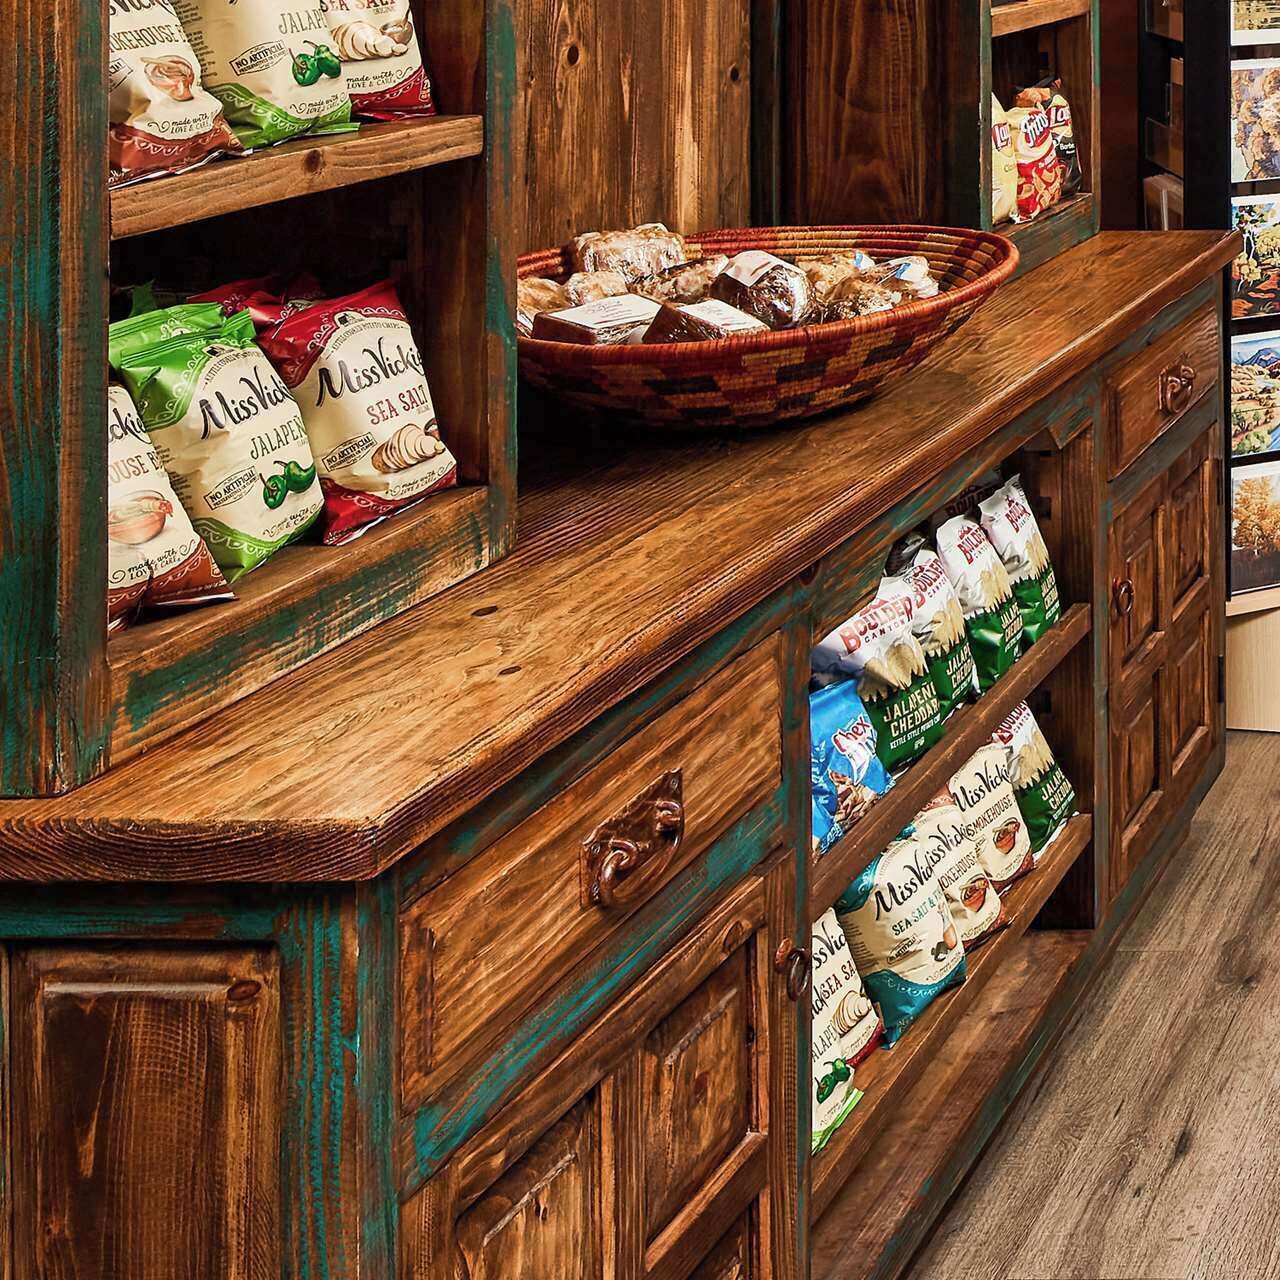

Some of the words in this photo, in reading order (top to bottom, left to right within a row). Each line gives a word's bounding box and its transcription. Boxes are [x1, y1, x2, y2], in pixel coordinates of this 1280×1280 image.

[235, 56, 249, 69] NO
[249, 42, 285, 65] ARTIFICIAL
[346, 75, 370, 85] made
[373, 70, 394, 82] with
[346, 81, 367, 90] LOVE
[171, 116, 192, 127] made
[171, 125, 187, 135] LOVE
[316, 359, 381, 408] Miss
[200, 390, 259, 441] Miss
[366, 398, 400, 425] SEA
[398, 384, 429, 412] SALT
[326, 453, 338, 466] NO
[337, 434, 374, 461] ARTIFICIAL
[209, 489, 223, 502] NO
[223, 470, 257, 496] ARTIFICIAL
[127, 557, 156, 574] made
[157, 548, 178, 564] with
[840, 595, 914, 656] BOULDER
[832, 714, 870, 754] Chex
[890, 699, 941, 738] CHEDDAR
[889, 735, 907, 750] KETTLE
[907, 728, 921, 742] STYLE
[873, 880, 919, 921] Miss
[892, 916, 912, 937] SEA
[912, 904, 930, 924] SALT
